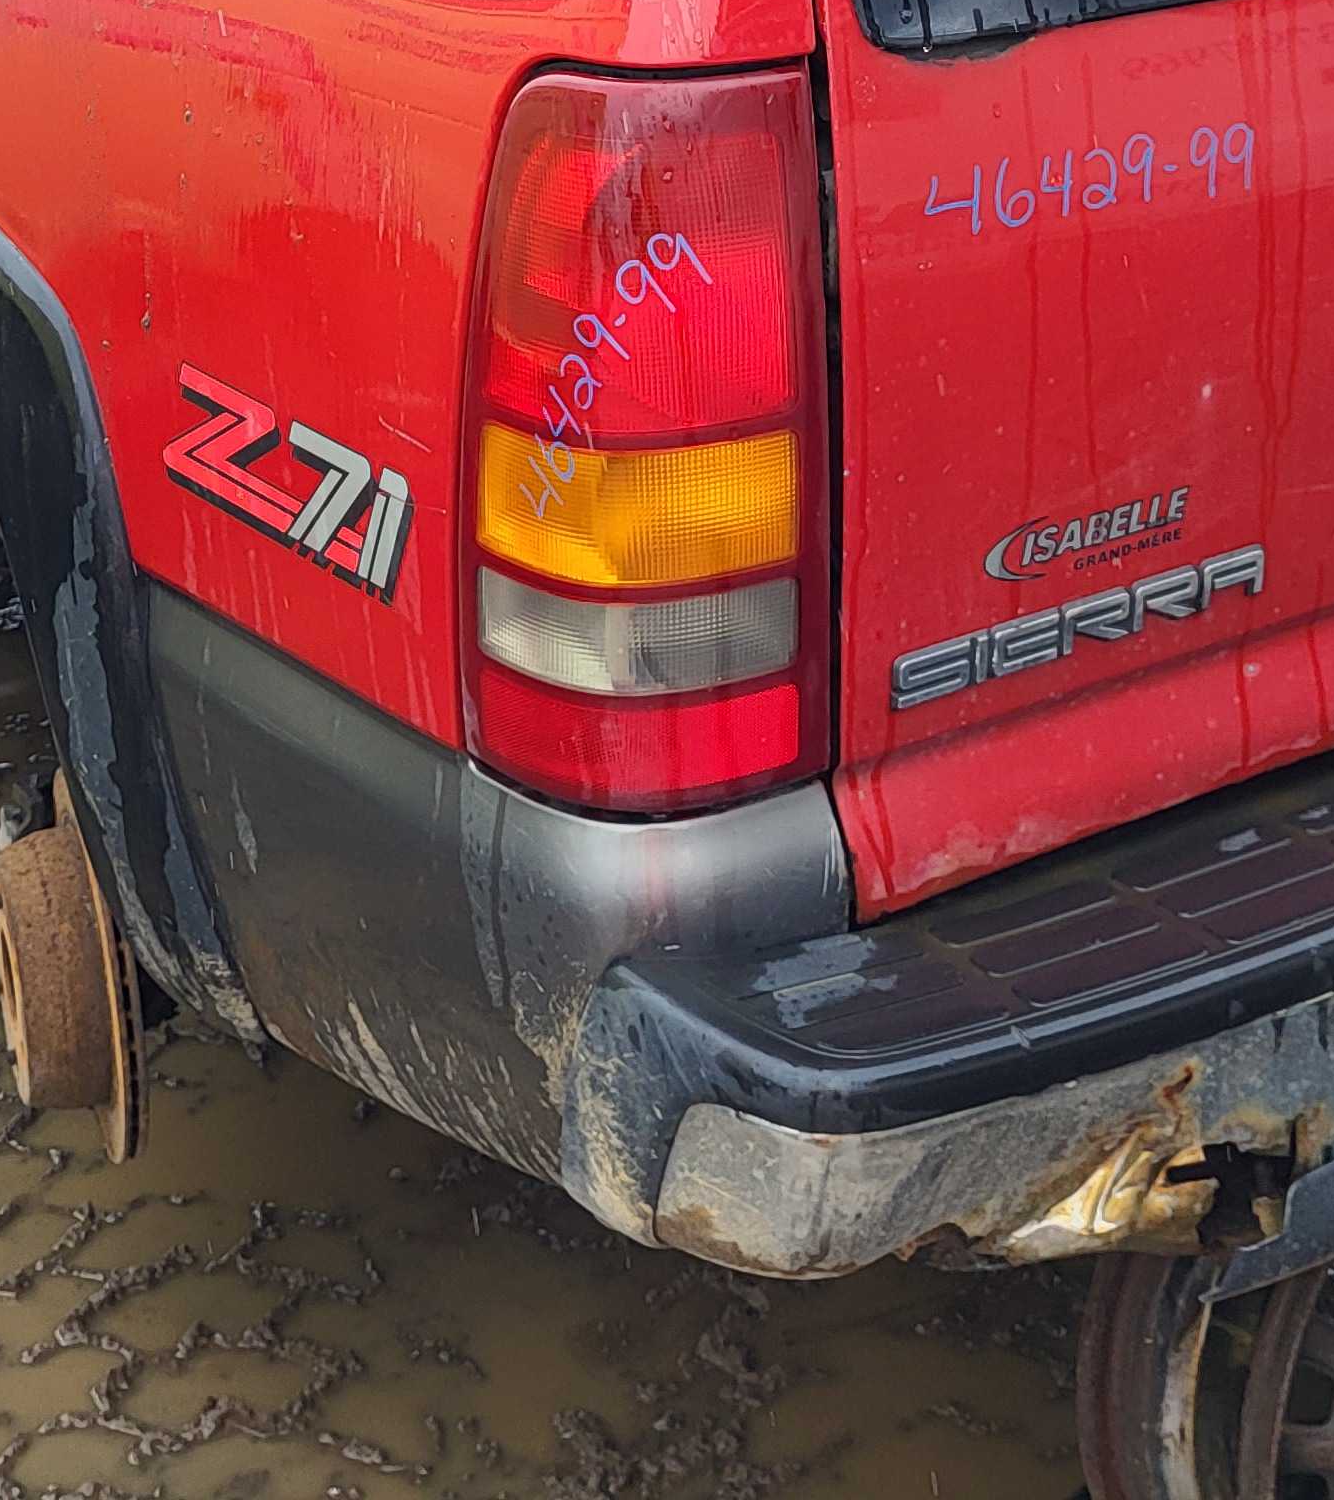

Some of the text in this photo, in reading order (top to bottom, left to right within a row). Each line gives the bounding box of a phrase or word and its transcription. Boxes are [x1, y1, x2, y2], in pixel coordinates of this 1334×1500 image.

[925, 123, 1255, 234] 46429-99
[519, 231, 715, 519] 46429-99
[162, 361, 415, 605] Z71
[1020, 485, 1191, 566] ISABELLE
[891, 543, 1264, 710] SIERRA
